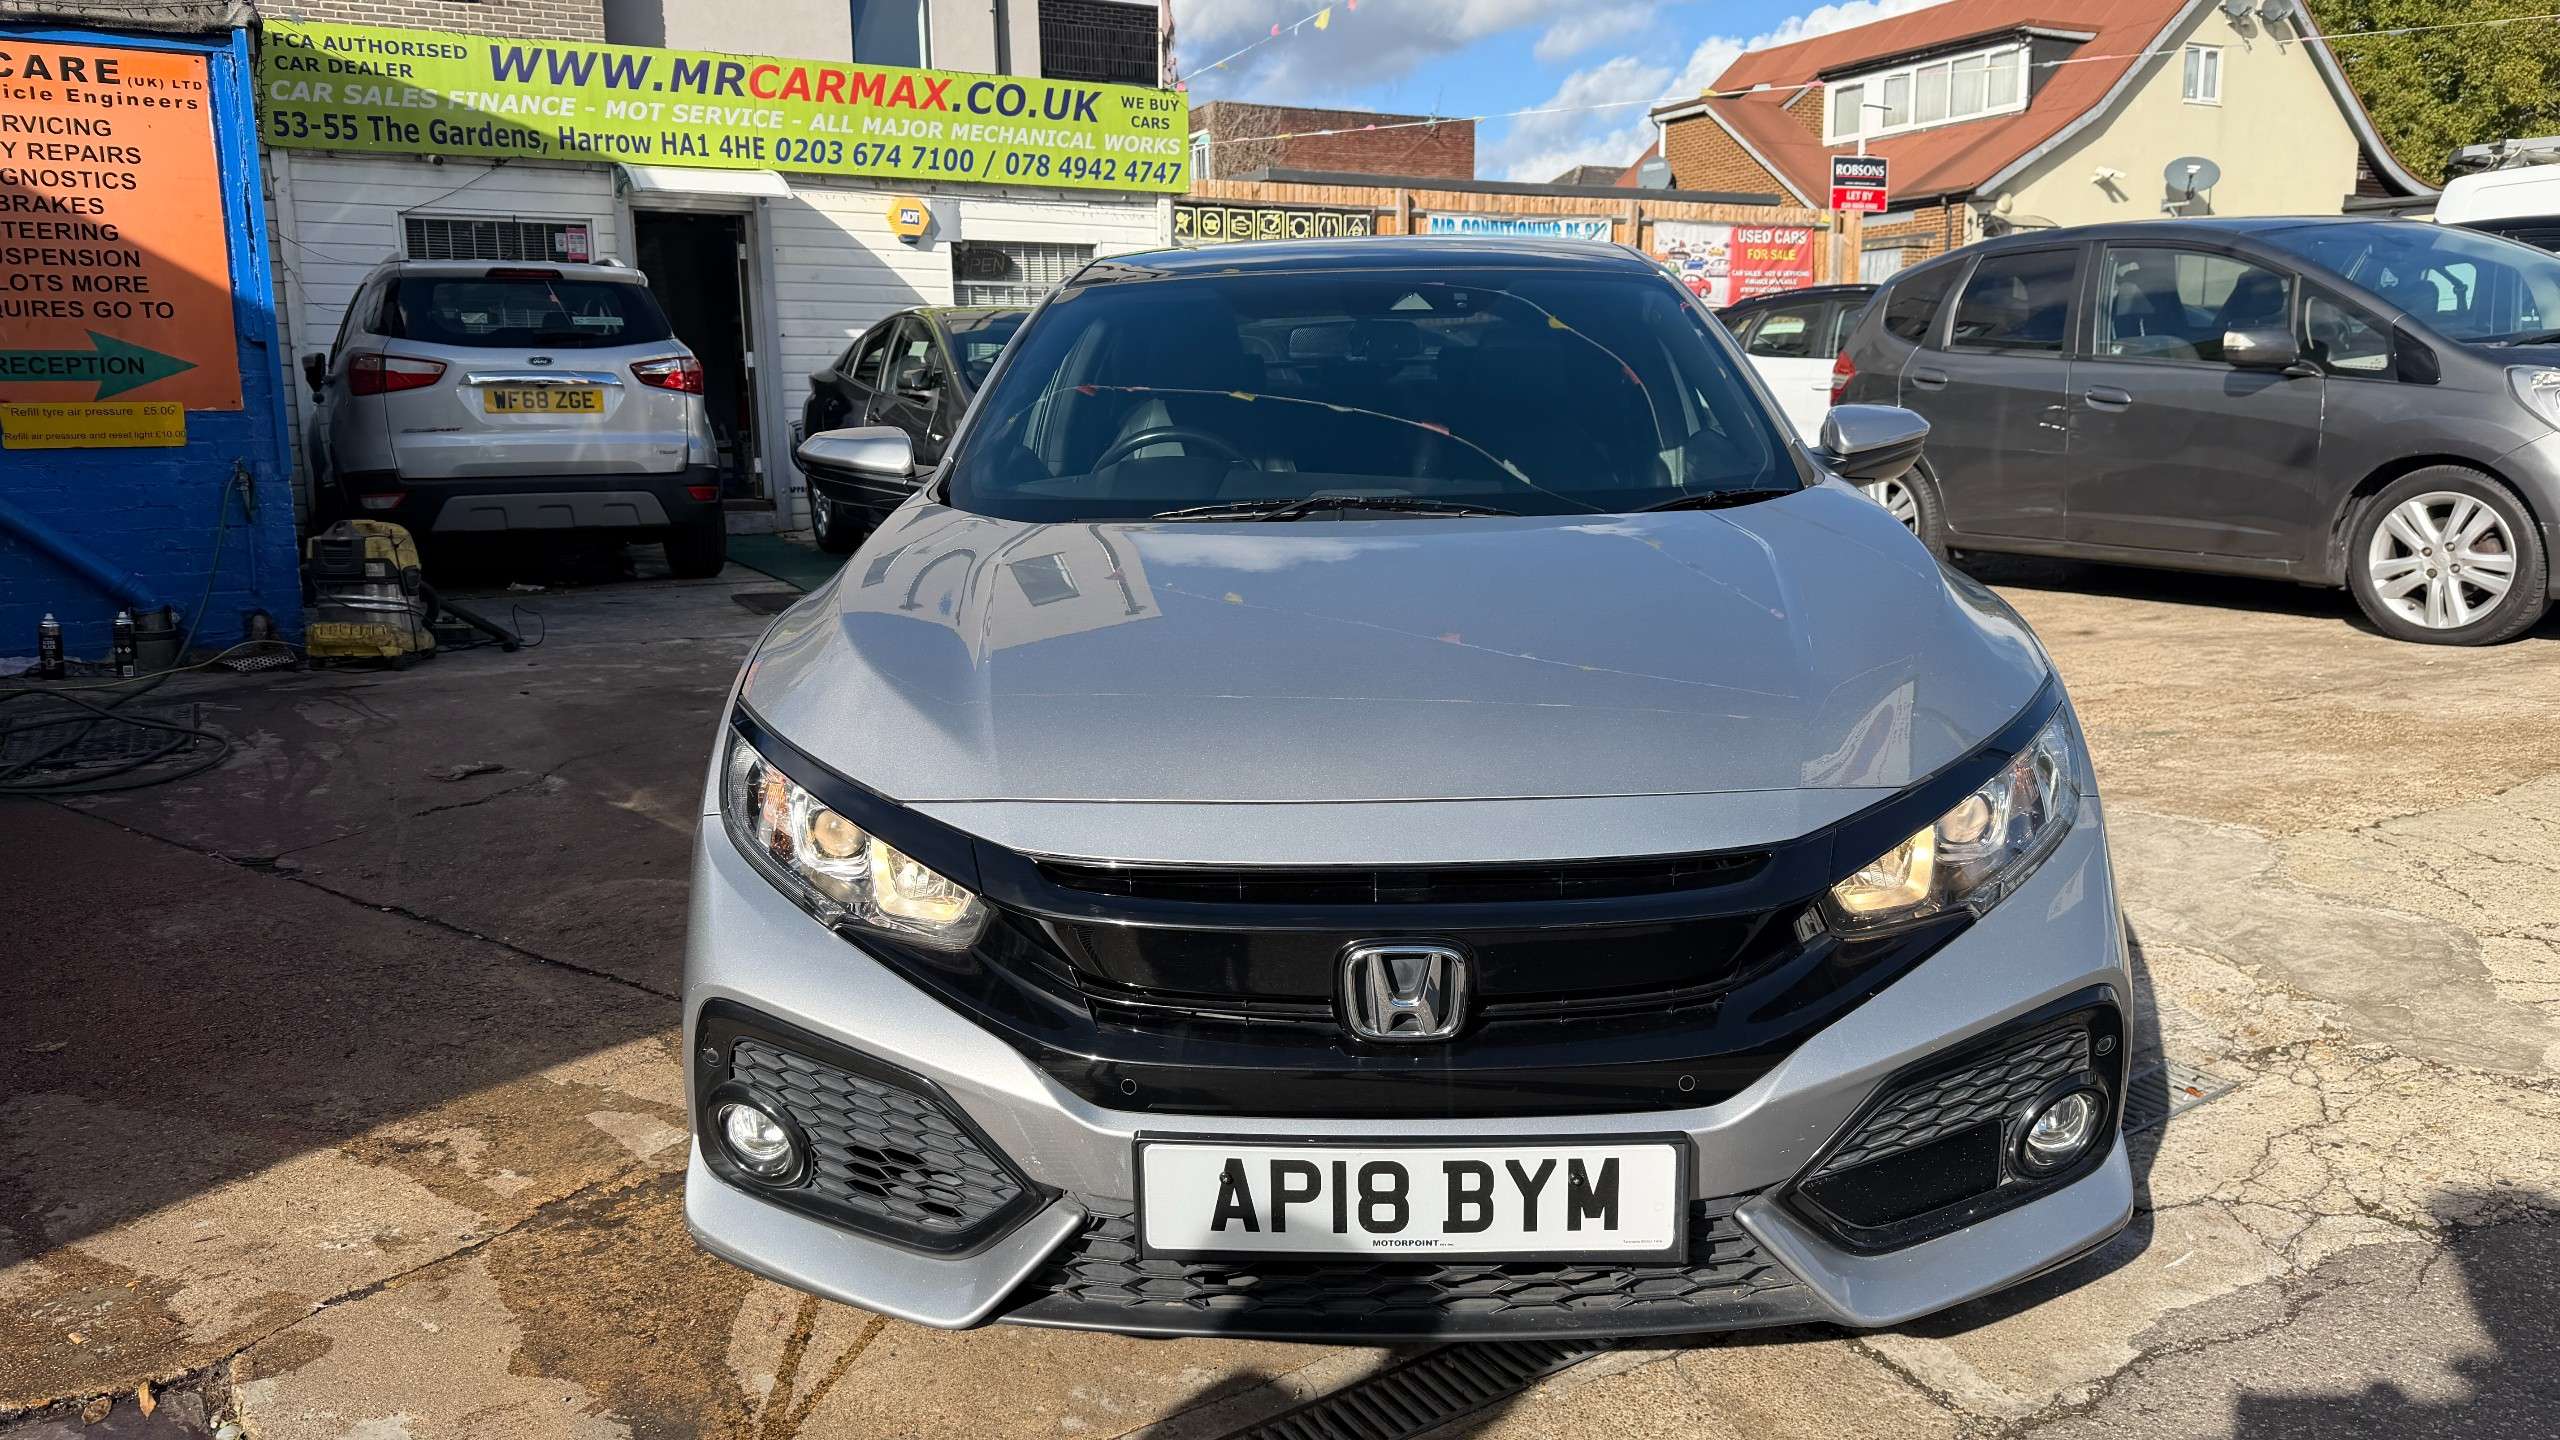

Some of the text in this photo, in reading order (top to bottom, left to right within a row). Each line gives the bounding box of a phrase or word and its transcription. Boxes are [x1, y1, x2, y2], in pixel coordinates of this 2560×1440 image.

[272, 33, 468, 60] FCA AUTHORISED
[274, 55, 414, 78] CAR DEALER
[127, 76, 165, 90] (UK)
[172, 79, 202, 91] LTD
[489, 44, 1103, 123] WWW.MRCARMAX.CO.UK
[3, 84, 199, 110] icle Engineers
[1121, 96, 1180, 112] WE BUY
[1, 114, 112, 137] RVICING
[270, 80, 333, 104] CAR
[344, 84, 438, 109] SALES
[449, 91, 577, 117] FINANCE
[604, 100, 665, 122] MOT
[672, 104, 785, 129] SERVICE
[809, 113, 854, 134] ALL
[862, 117, 943, 139] MAJOR
[950, 124, 1096, 150] MECHANICAL
[1104, 134, 1182, 155] WORKS
[1131, 115, 1171, 130] CARS
[27, 142, 142, 164] REPAIRS
[273, 111, 359, 141] 53-55
[367, 115, 420, 144] The
[429, 118, 548, 155] Gardens,
[558, 125, 652, 154] Harrow
[661, 131, 710, 158] HA1
[719, 133, 766, 161] 4HE
[775, 137, 844, 165] 0203
[853, 142, 902, 169] 674
[912, 145, 975, 173] 7100
[1005, 152, 1051, 178] 078
[1058, 156, 1117, 182] 4942
[1124, 160, 1183, 185] 4747
[0, 168, 137, 190] GNOSTICS
[1835, 163, 1885, 177] ROBSONS
[1846, 190, 1874, 201] LET BY
[901, 211, 919, 223] ADT
[1, 221, 119, 242] TEERING
[1738, 229, 1808, 245] USED CARS
[0, 247, 141, 268] SPENSION
[1747, 248, 1797, 261] FOR SALE
[72, 275, 150, 293] MORE
[0, 300, 175, 319] UIRES GO TO
[493, 390, 595, 409] WF68 ZGE
[10, 406, 40, 417] Refill
[43, 408, 65, 419] tyre
[67, 407, 82, 417] air
[85, 407, 134, 418] pressure
[4, 432, 29, 441] Refill
[31, 433, 43, 441] air
[45, 433, 87, 442] pressure
[88, 431, 107, 440] and
[1210, 1156, 1620, 1234] AP18 BYM
[1372, 1239, 1440, 1247] MOTORPOINT
